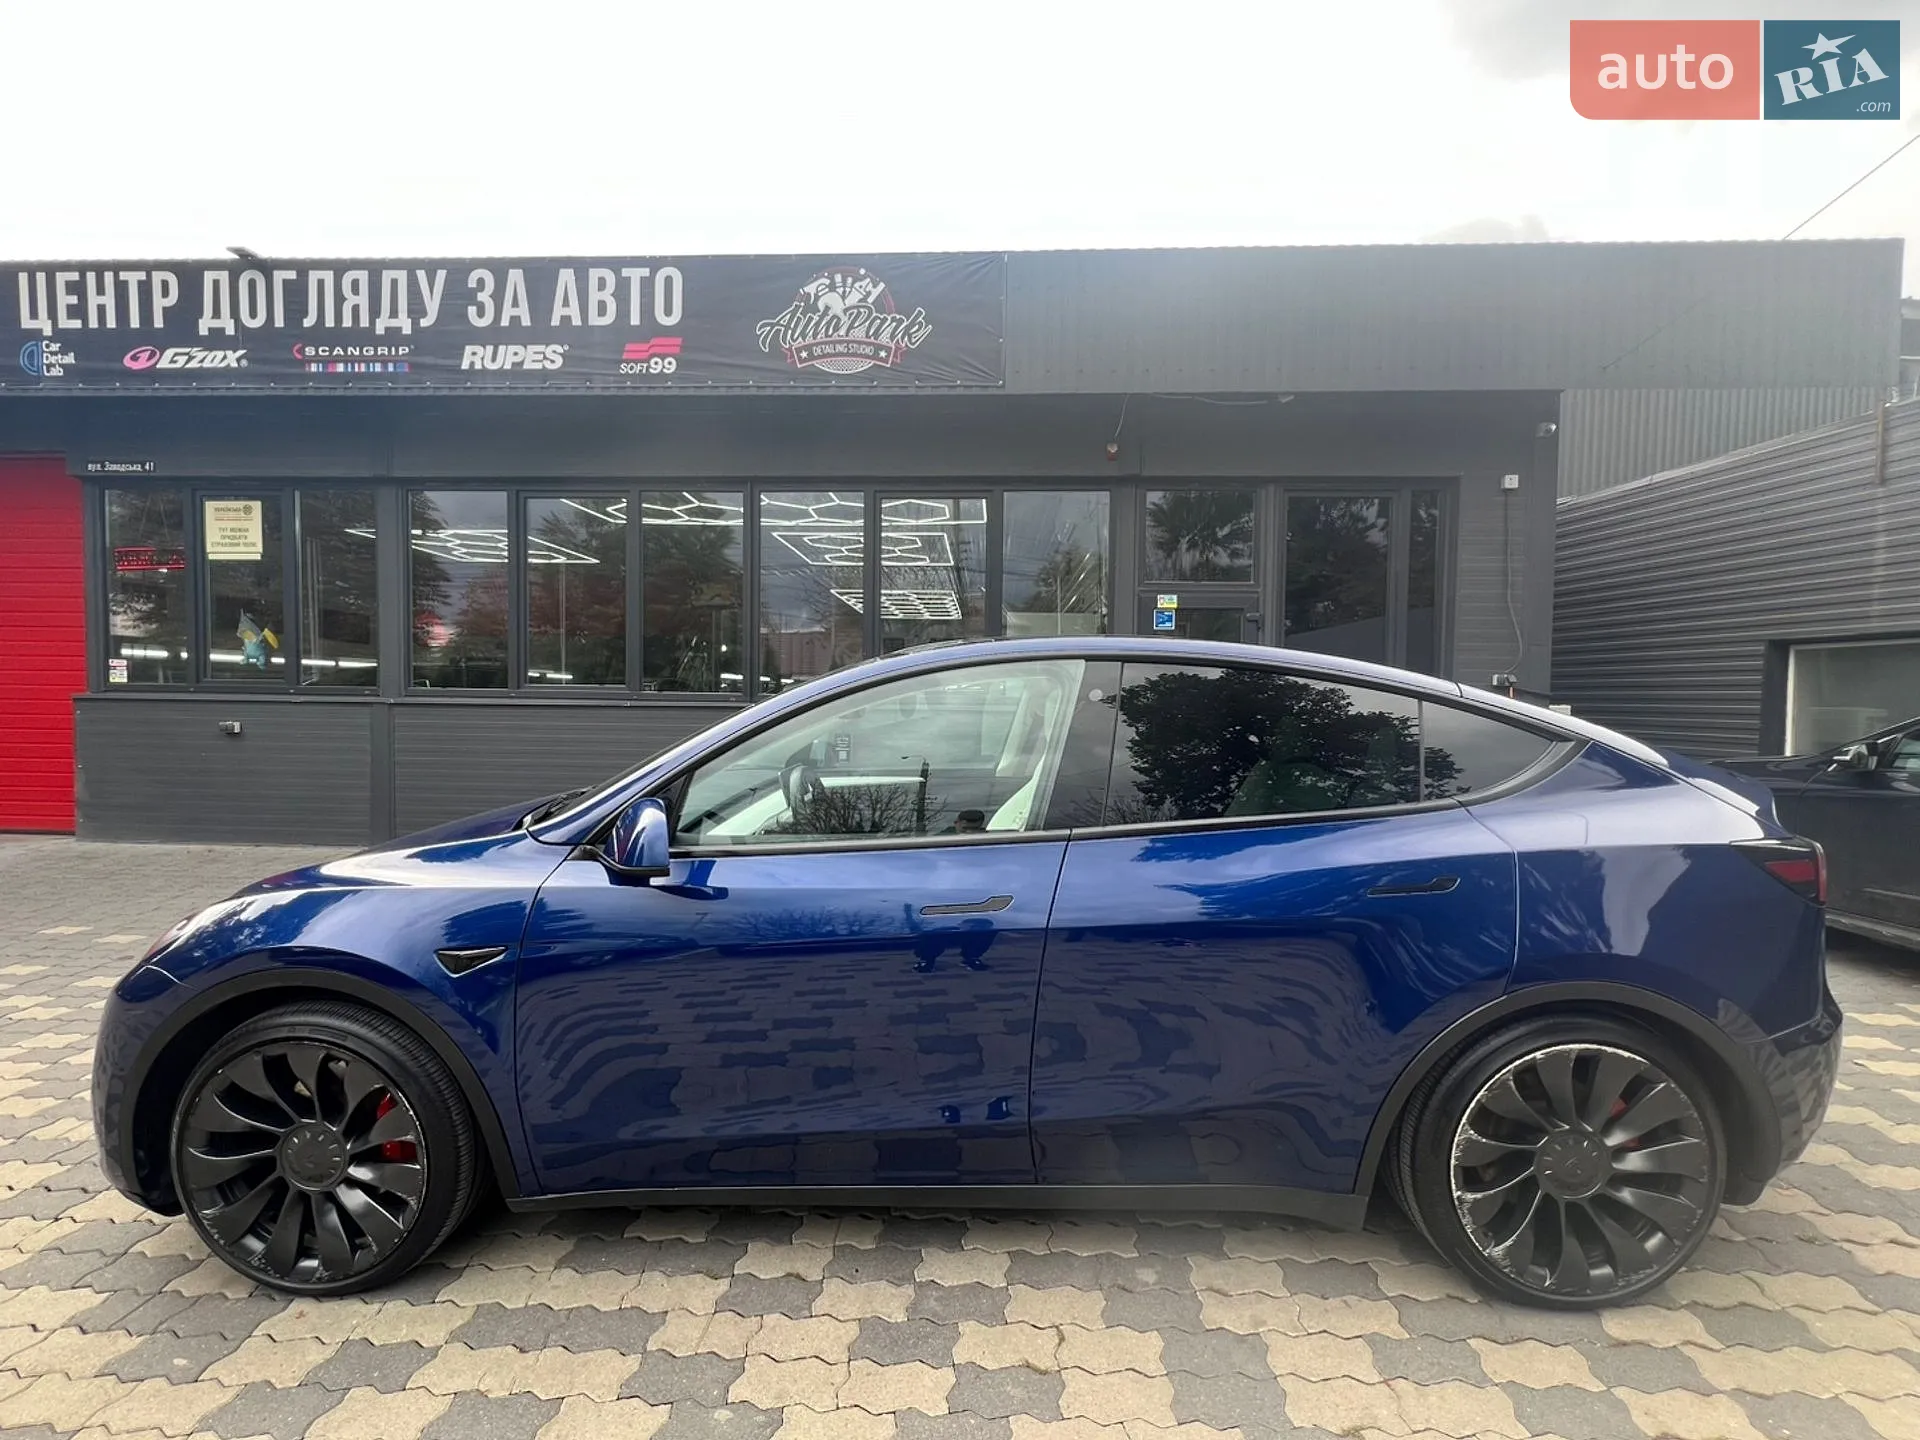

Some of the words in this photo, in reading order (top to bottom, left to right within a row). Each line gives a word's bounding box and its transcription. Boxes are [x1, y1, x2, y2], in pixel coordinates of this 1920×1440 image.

[17, 270, 179, 336] ЦЕНТР
[198, 268, 448, 336] ДОГЛЯДУ
[467, 267, 532, 328] ЗА
[550, 266, 684, 327] АВТО
[42, 341, 62, 353] Car
[303, 345, 411, 357] SCANGRIP
[812, 343, 848, 357] DETAILING
[848, 343, 875, 356] STUDIO
[42, 352, 76, 365] Detail
[460, 344, 565, 370] RUPES
[43, 364, 64, 377] Lab
